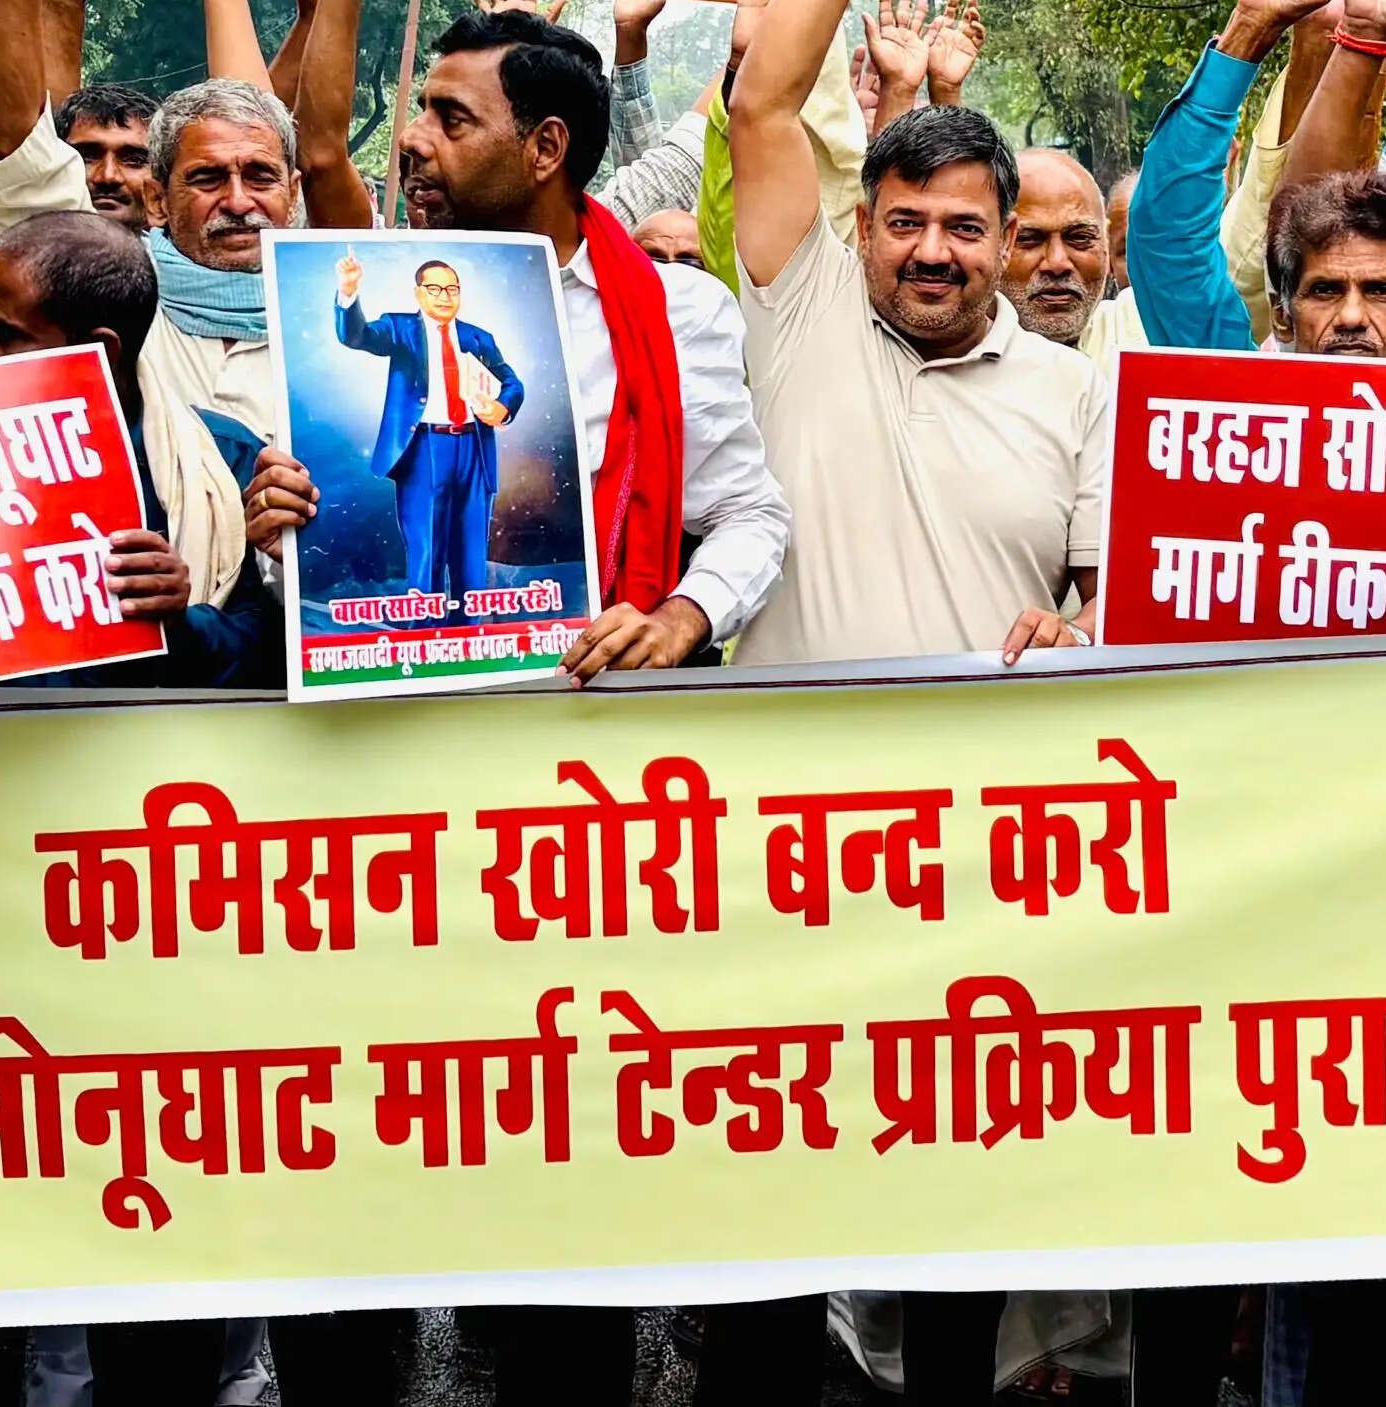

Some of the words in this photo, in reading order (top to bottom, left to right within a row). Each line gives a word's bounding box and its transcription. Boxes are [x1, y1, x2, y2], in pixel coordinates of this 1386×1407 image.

[1147, 397, 1309, 487] बरहज
[24, 512, 123, 630] करो
[384, 588, 446, 621] साहेब
[464, 588, 521, 616] अमर
[1151, 512, 1265, 624] मार्ग
[307, 635, 393, 673] समाजवादी
[34, 782, 448, 960] कमिसन
[476, 756, 728, 942] खोरी
[758, 788, 954, 927] बन्द
[980, 738, 1177, 916] करो
[367, 986, 578, 1168] मार्ग
[600, 990, 844, 1158] टेन्डर
[866, 975, 1202, 1156] प्रक्रिया
